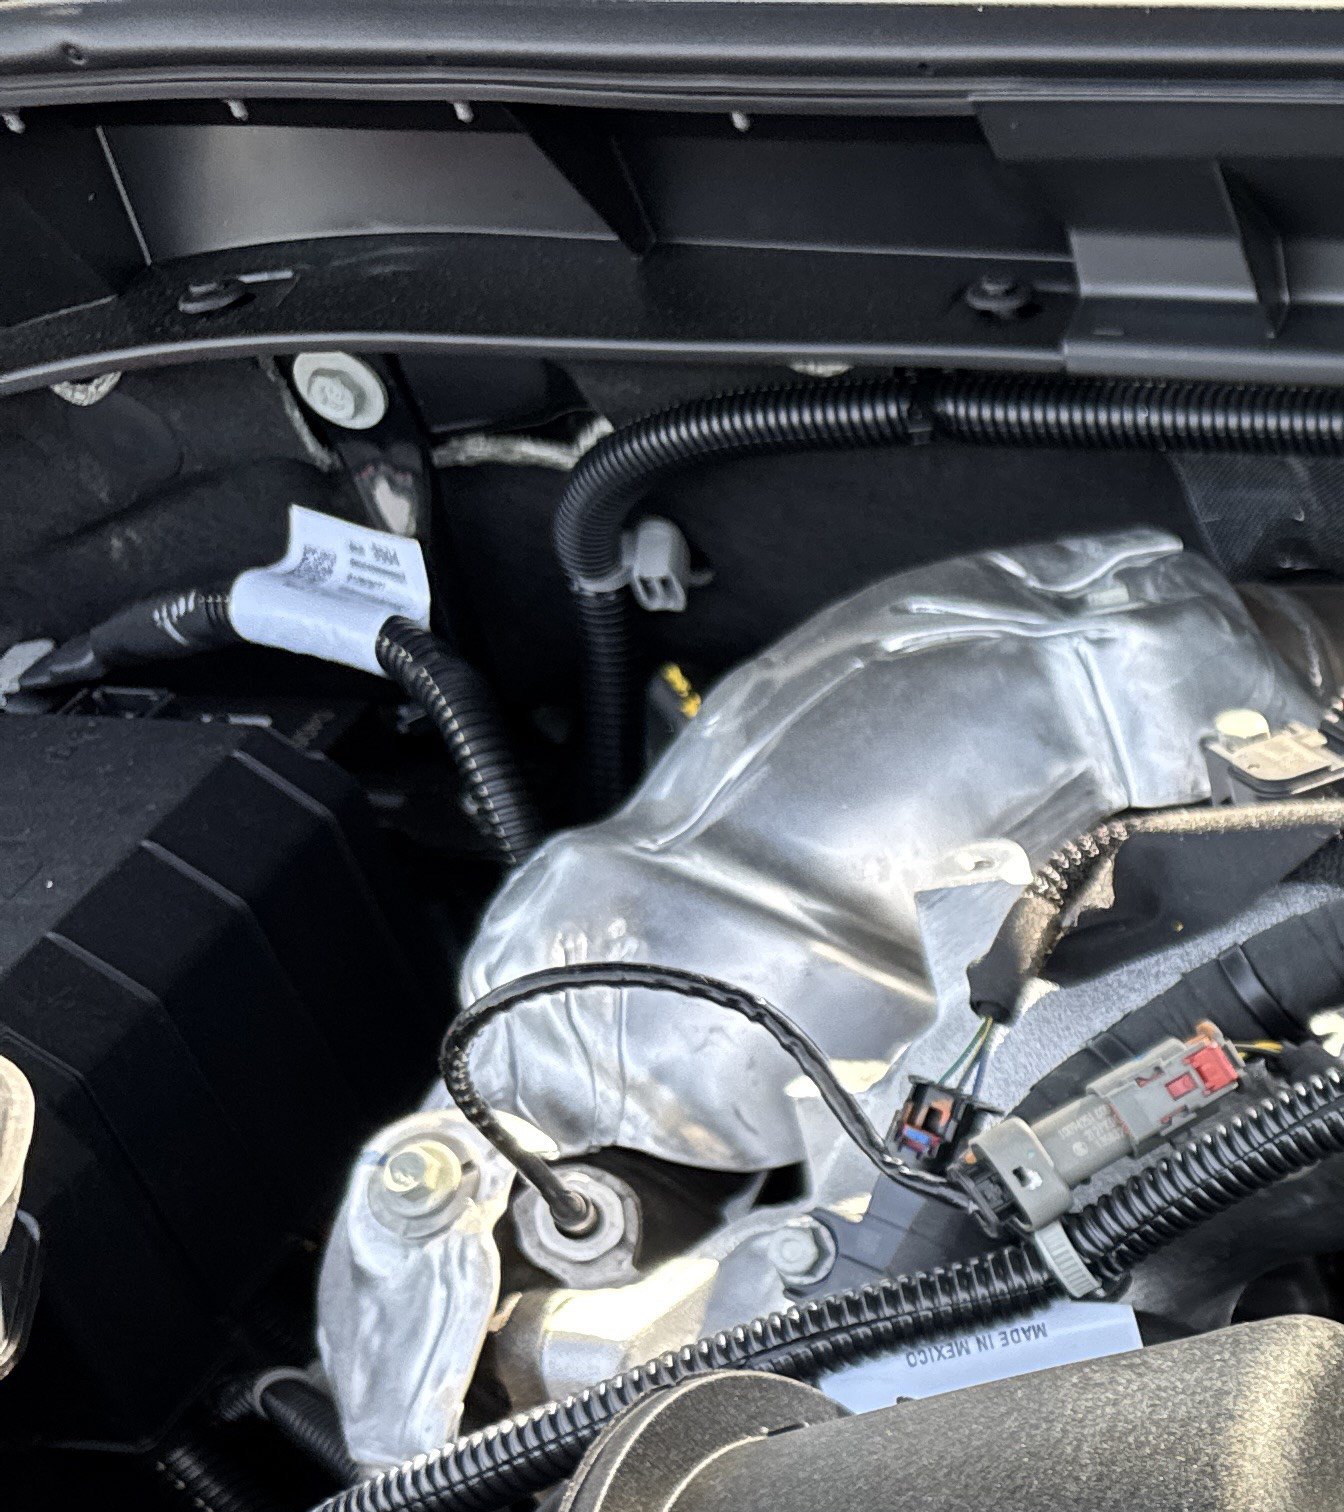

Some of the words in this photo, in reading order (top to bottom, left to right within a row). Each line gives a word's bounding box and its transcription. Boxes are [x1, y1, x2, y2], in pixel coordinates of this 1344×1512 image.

[975, 1336, 995, 1354] IN
[1001, 1322, 1047, 1348] MADE
[907, 1342, 972, 1368] MEXICO
